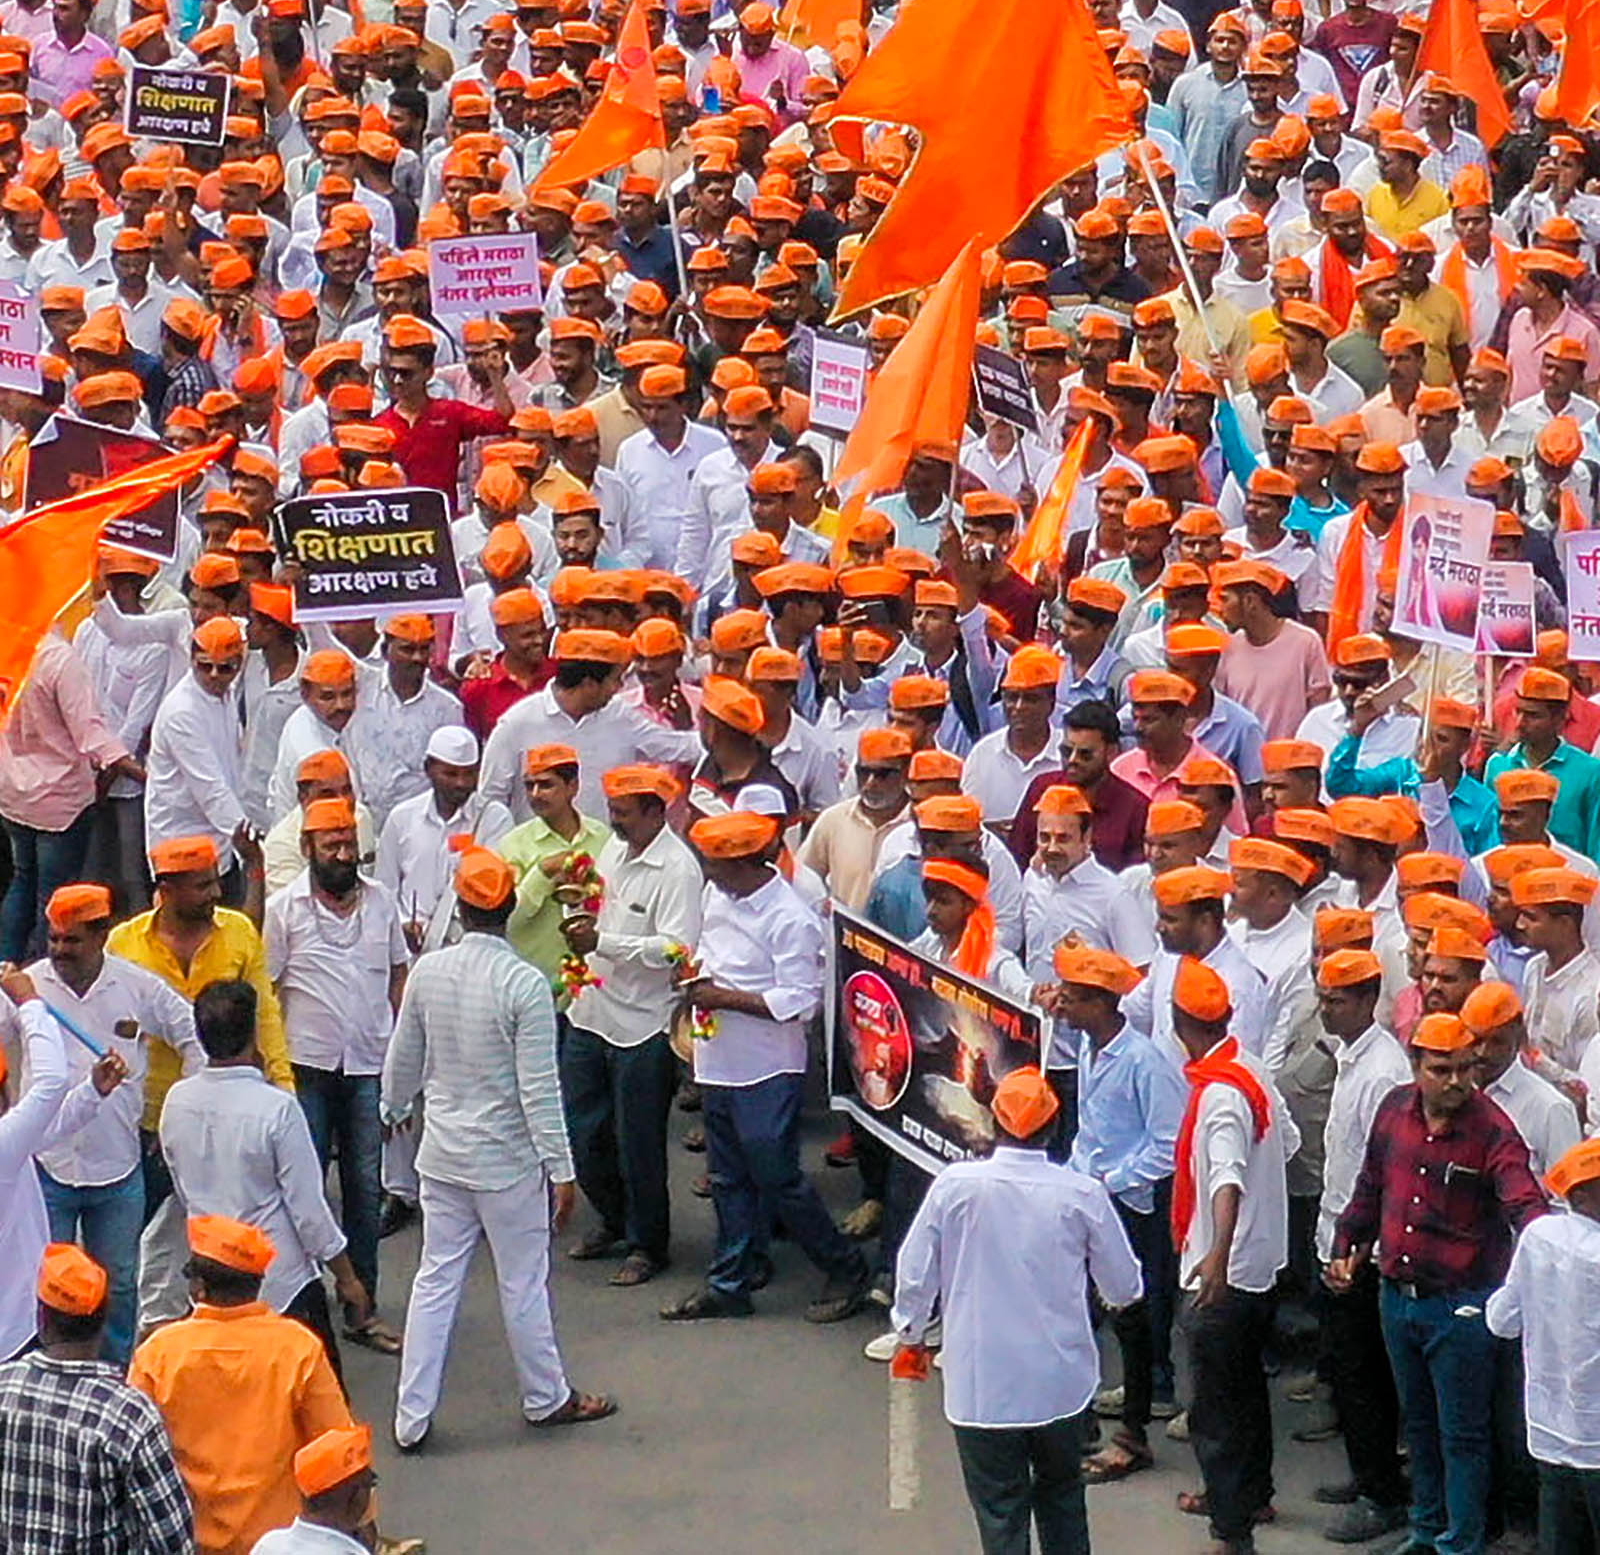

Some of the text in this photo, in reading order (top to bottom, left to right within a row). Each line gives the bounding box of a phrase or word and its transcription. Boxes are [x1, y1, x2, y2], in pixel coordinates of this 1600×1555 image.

[136, 84, 218, 115] शिक्षणात
[135, 114, 212, 136] आरक्षण हवे
[438, 244, 526, 267] पहिले मराठा
[456, 266, 513, 286] आरक्षण
[472, 281, 534, 303] इलेक्शन
[310, 498, 411, 528] नोकरी व
[292, 529, 437, 564] शिक्षणात
[308, 563, 439, 595] आरक्षण हवे
[1447, 559, 1483, 587] मराठा
[1498, 601, 1532, 620] मराठा
